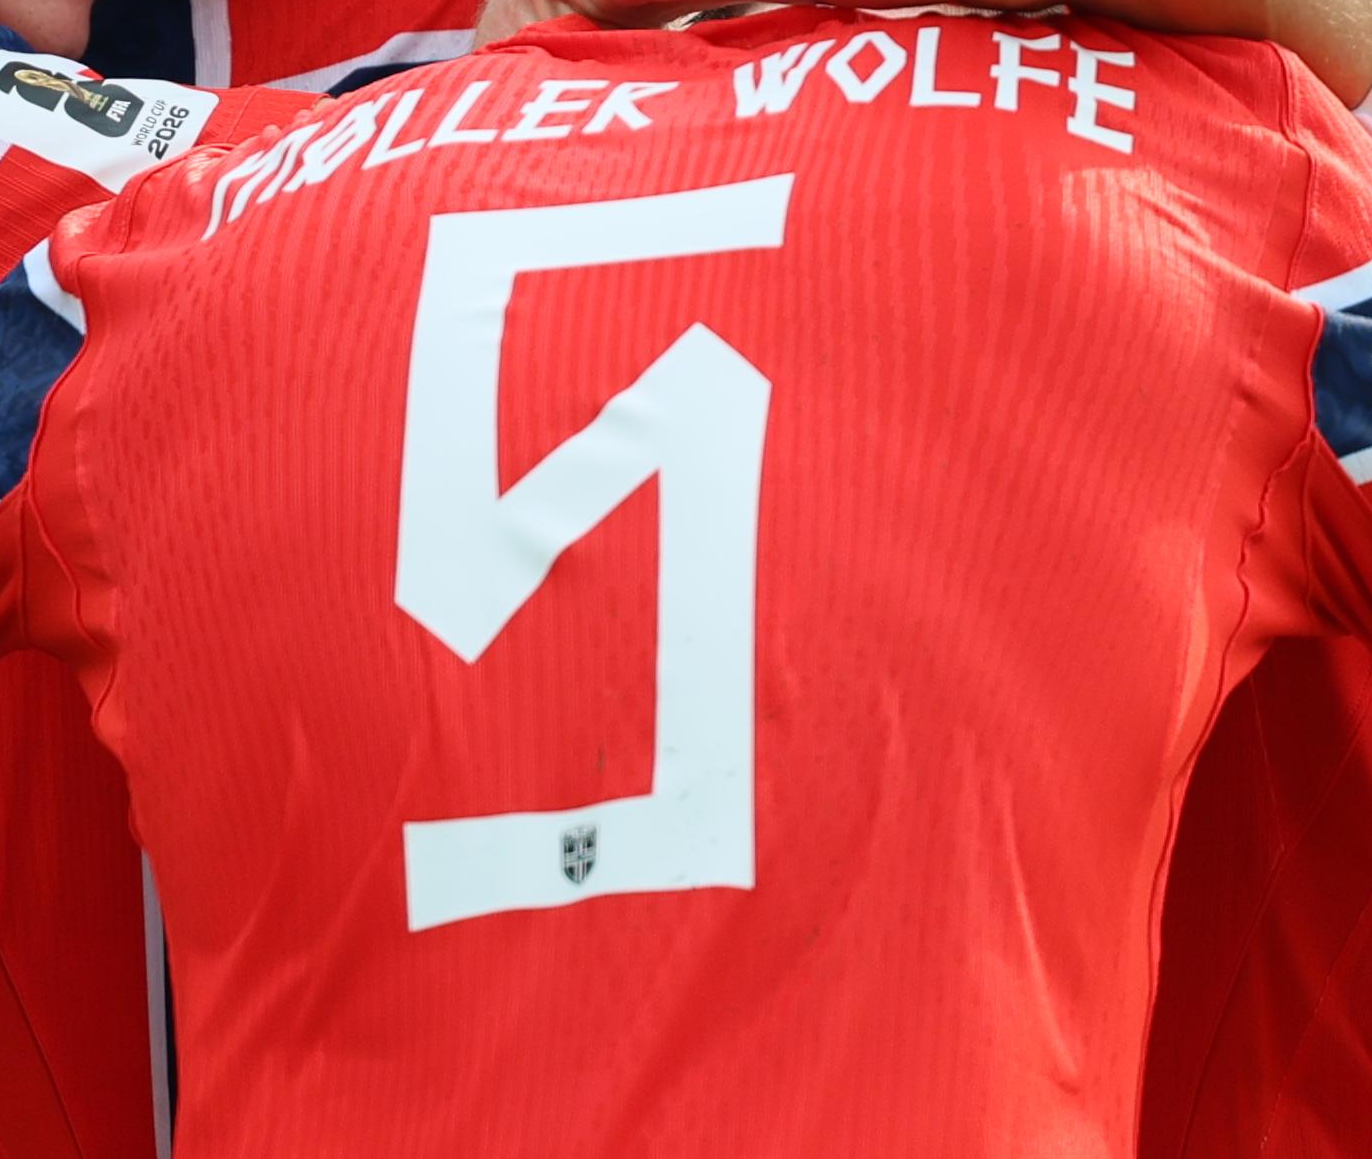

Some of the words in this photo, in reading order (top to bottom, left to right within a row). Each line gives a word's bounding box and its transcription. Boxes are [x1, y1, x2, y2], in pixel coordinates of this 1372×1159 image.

[106, 99, 131, 123] FIFA
[132, 113, 158, 147] WORLD
[147, 105, 190, 160] 2026
[201, 79, 679, 241] MØLLER
[733, 26, 1135, 154] WOLFE
[394, 173, 796, 933] 5
